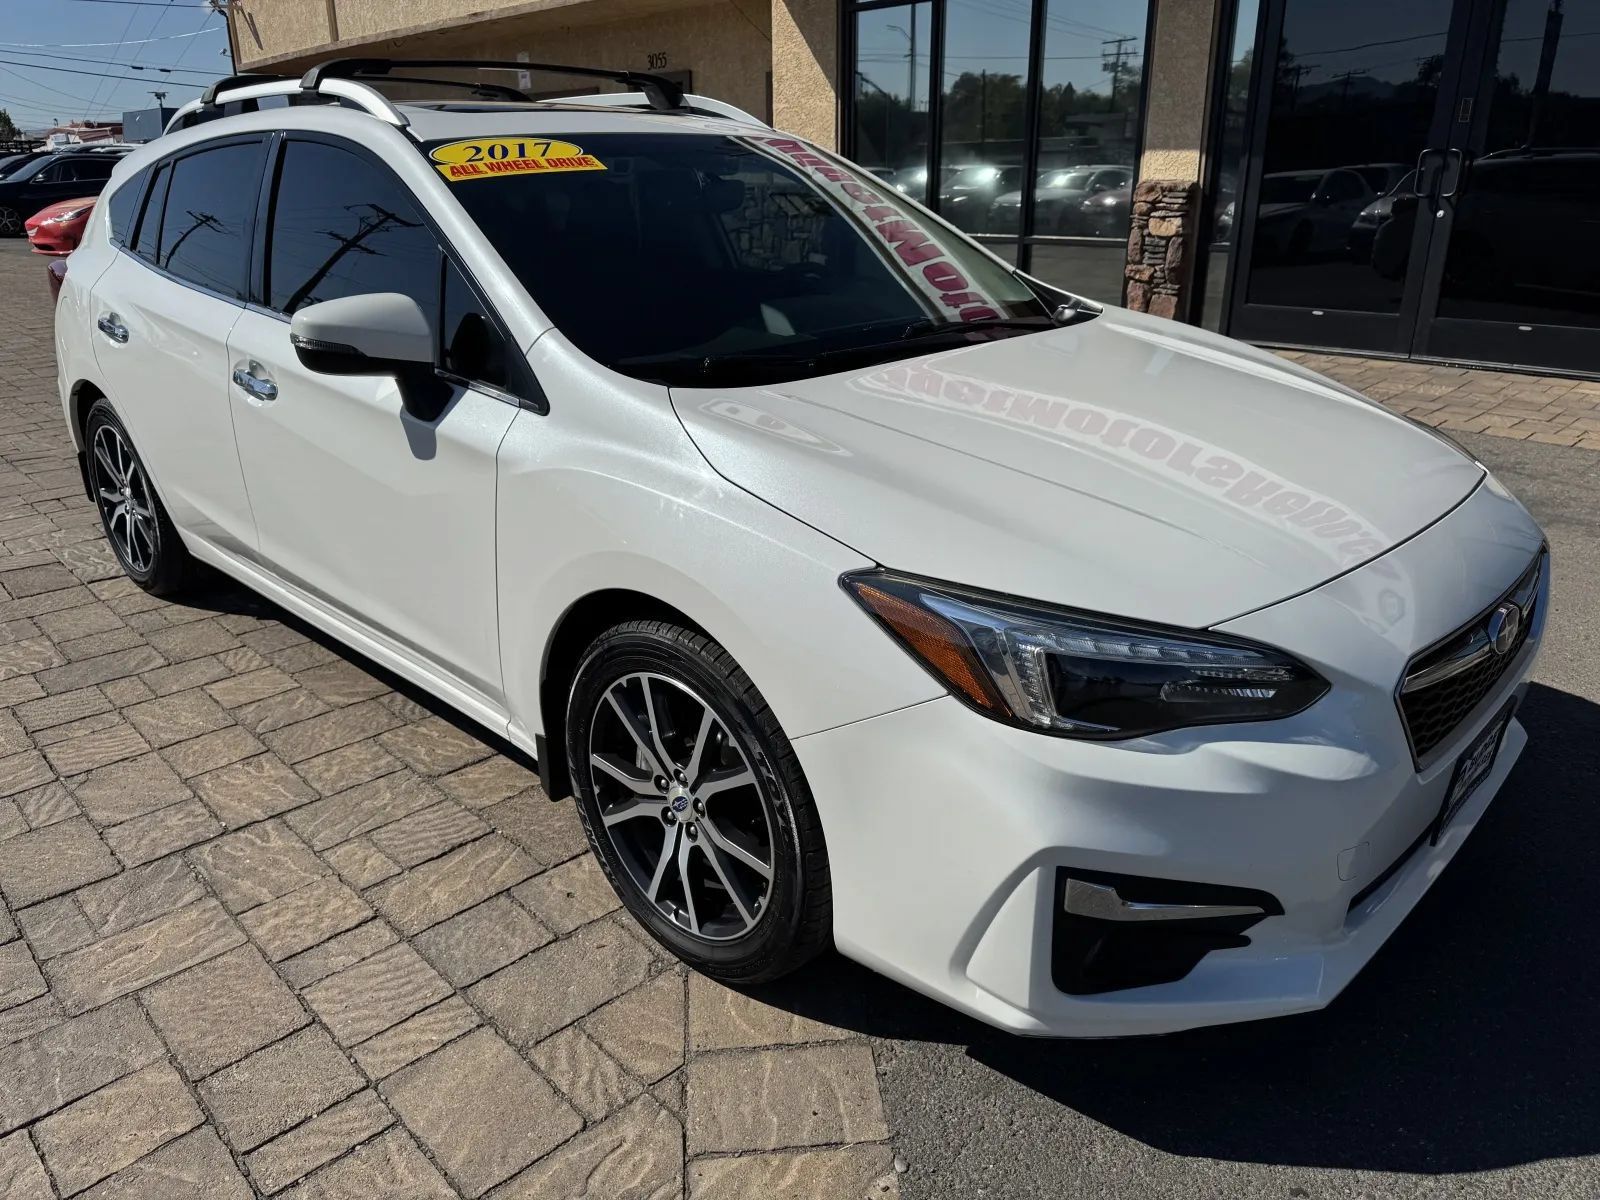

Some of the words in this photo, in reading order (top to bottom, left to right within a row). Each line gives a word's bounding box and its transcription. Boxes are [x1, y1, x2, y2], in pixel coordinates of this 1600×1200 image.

[647, 51, 667, 71] 3055
[463, 141, 552, 163] 2017
[449, 165, 487, 178] ALL
[483, 159, 548, 173] WHEEL
[547, 156, 598, 169] DRIVE
